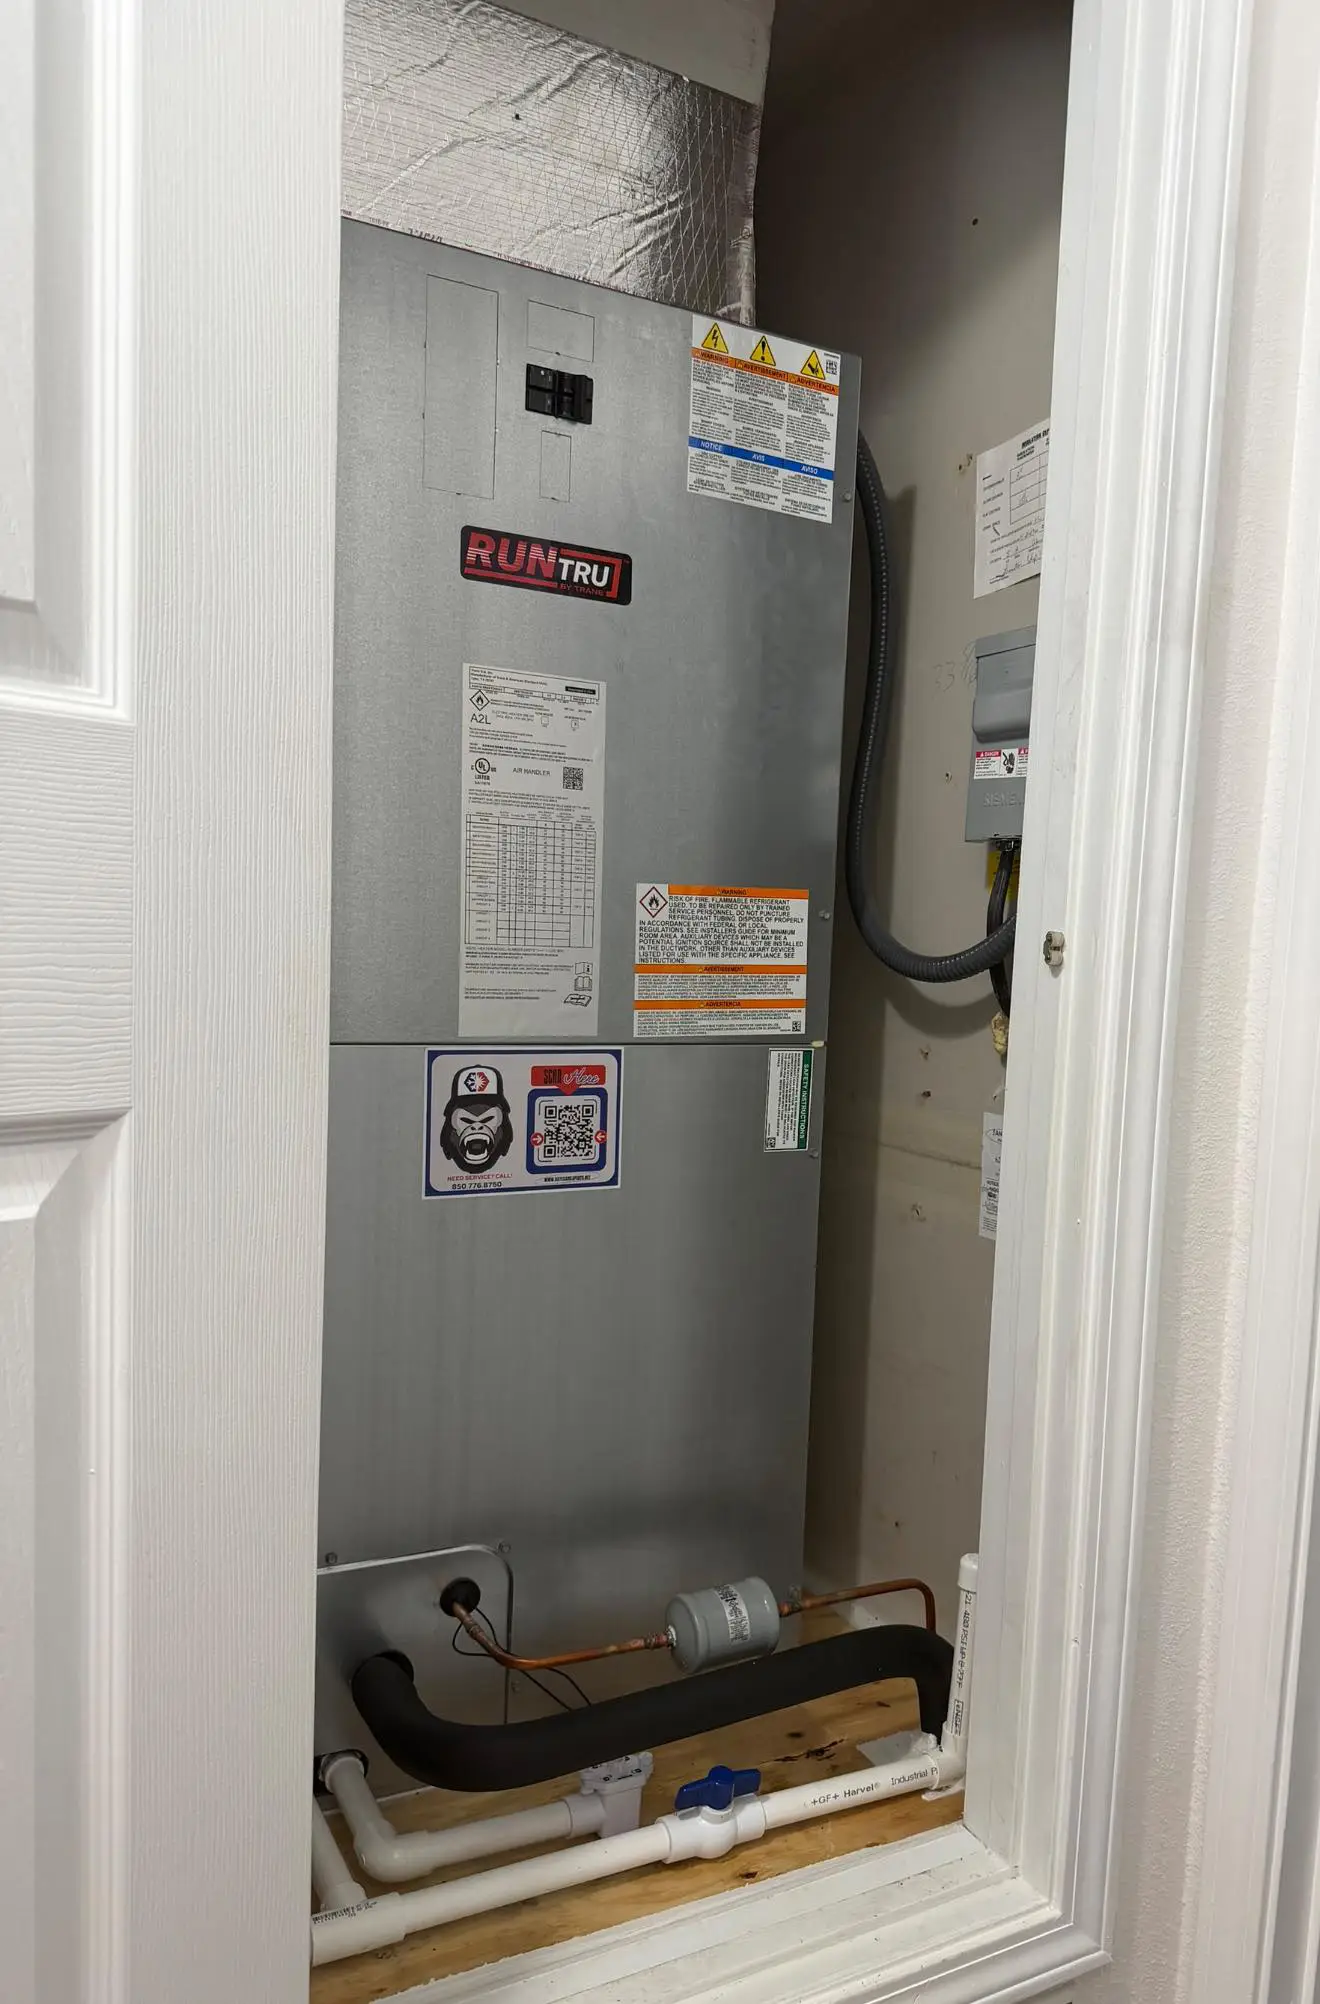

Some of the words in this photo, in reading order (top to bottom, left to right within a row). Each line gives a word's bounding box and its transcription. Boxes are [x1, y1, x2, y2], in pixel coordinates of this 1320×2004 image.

[701, 351, 729, 364] WARNING
[743, 363, 786, 378] AVERTISSEMENT
[796, 376, 836, 393] ADVERTENCIA
[700, 440, 723, 452] NOTICE
[752, 453, 765, 462] AVIS
[801, 465, 818, 475] AVISO
[575, 585, 607, 597] TRANE
[470, 713, 491, 725] A2L
[513, 767, 522, 775] AIR
[524, 768, 551, 777] HANDLER
[543, 1069, 562, 1085] SCAN
[563, 1066, 600, 1085] Here
[799, 1090, 807, 1139] INSTRUCTIONS
[891, 1769, 928, 1786] Industrial
